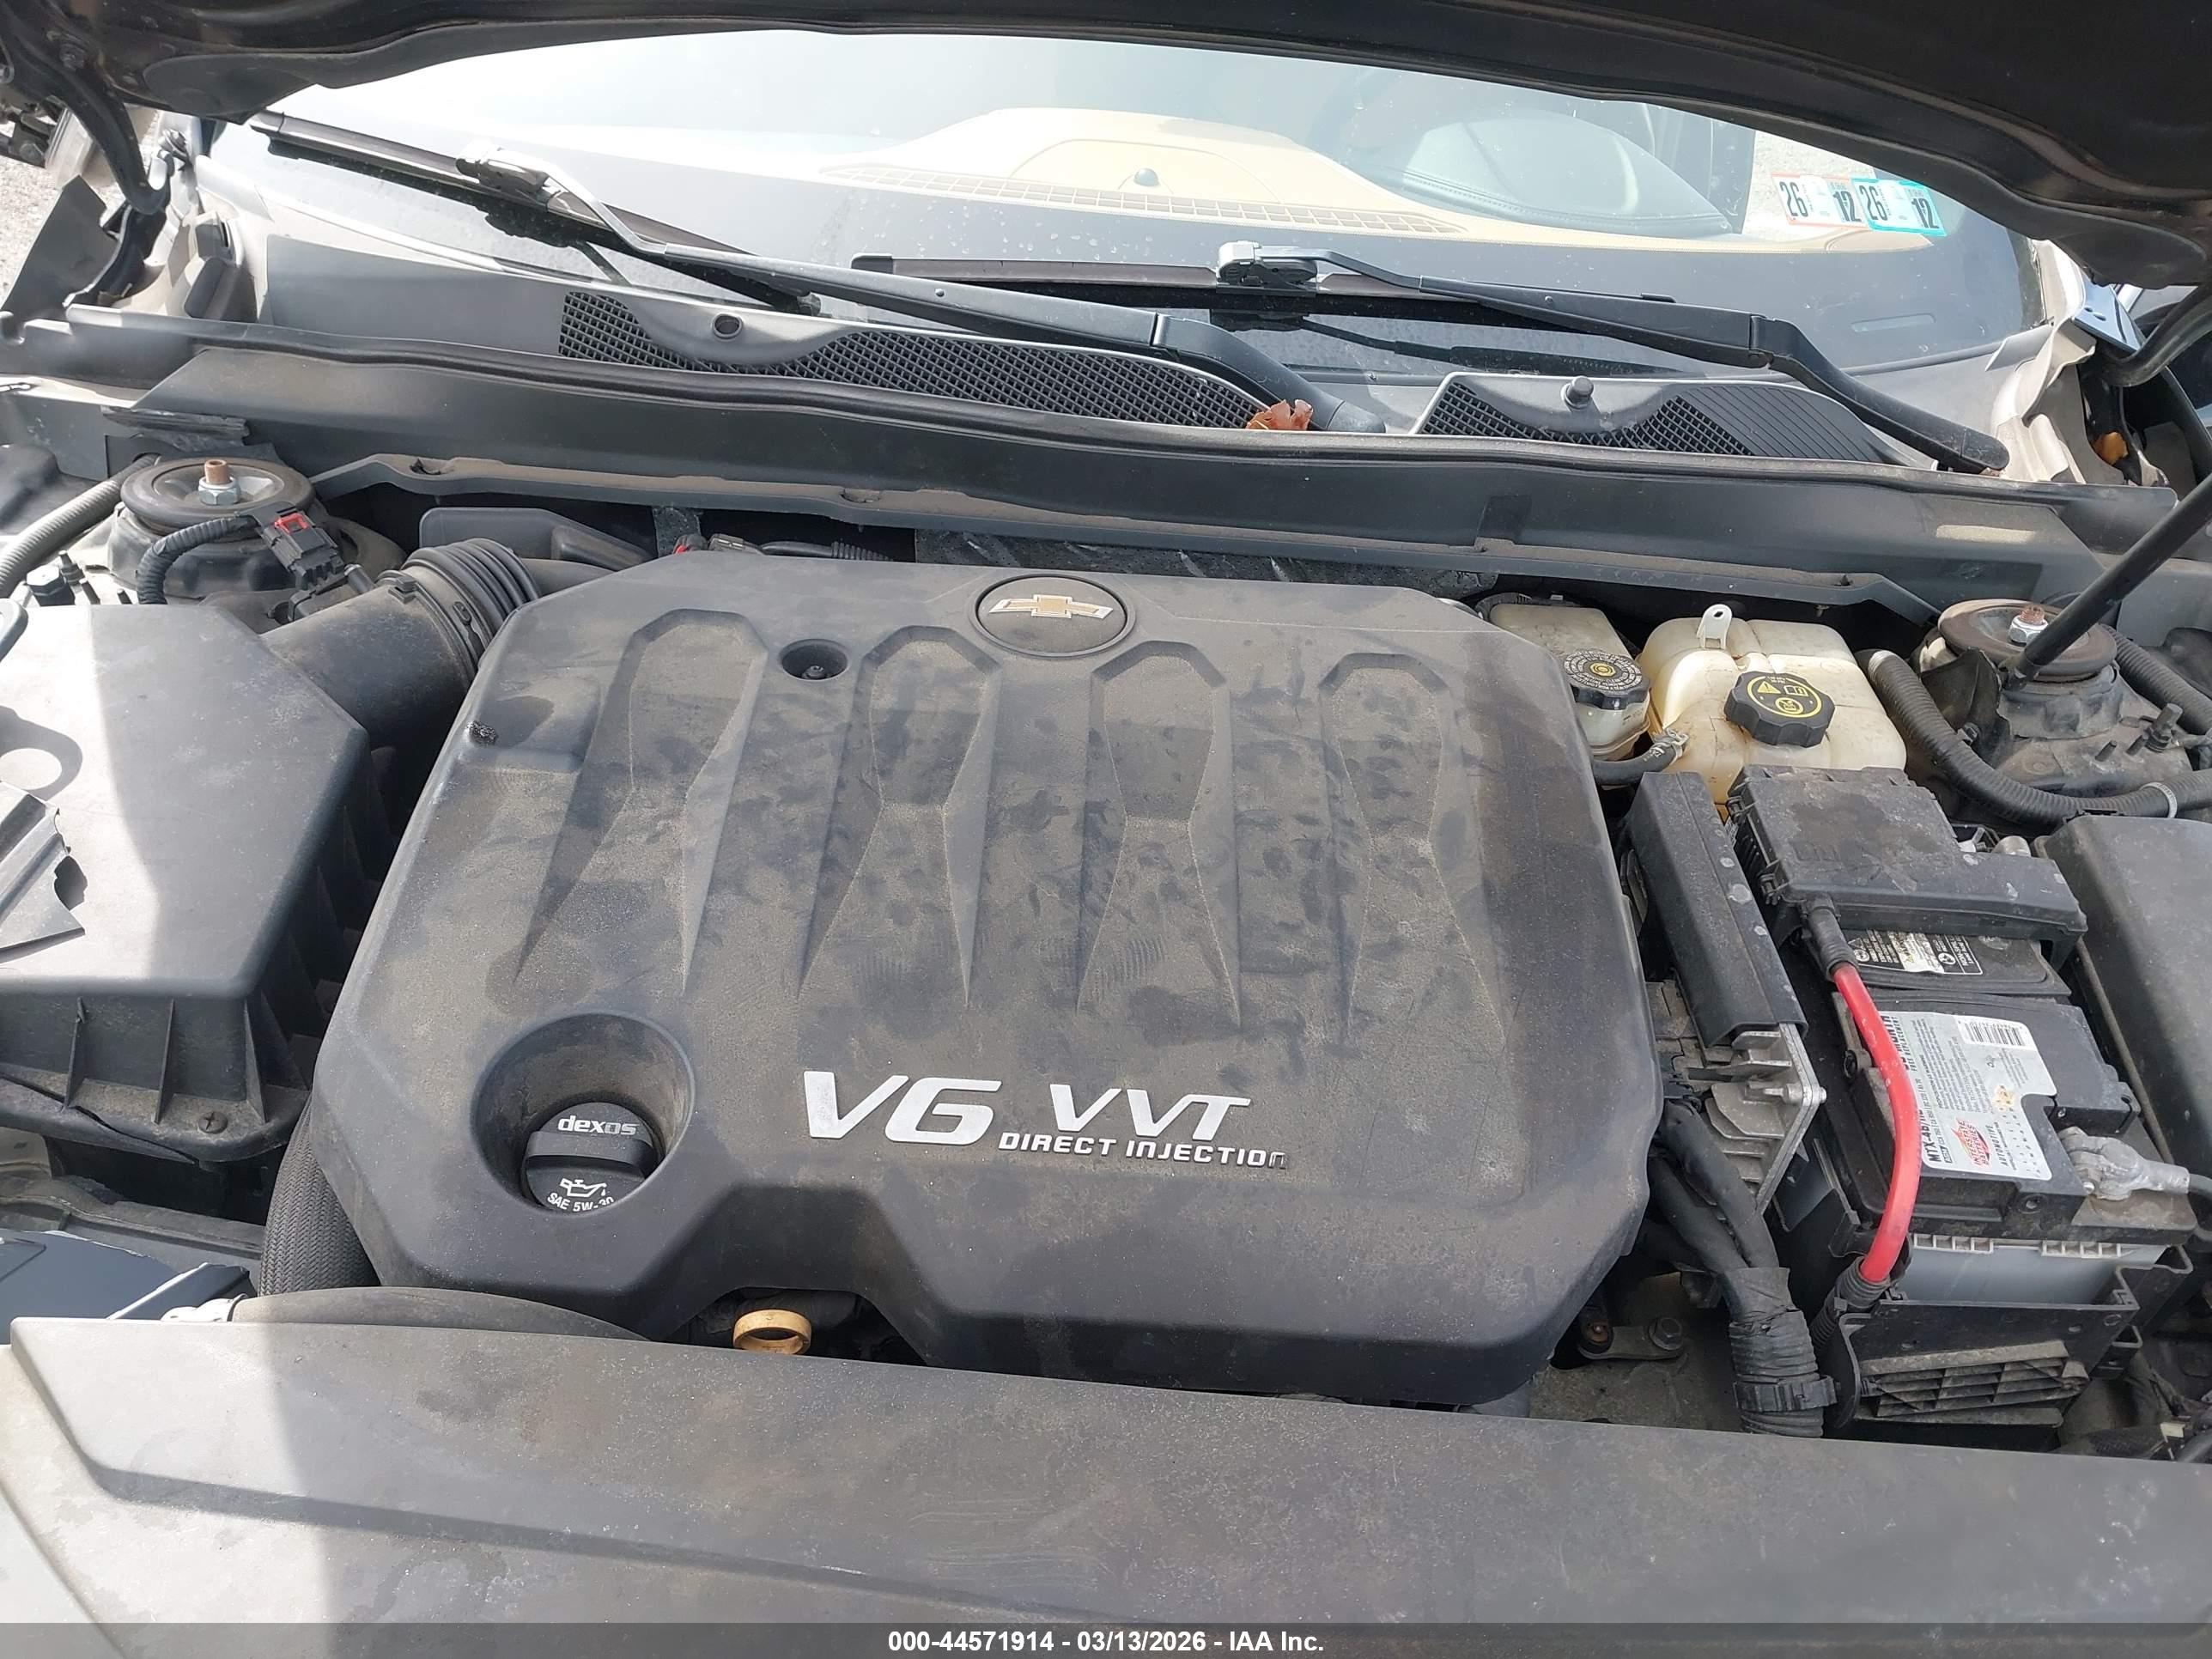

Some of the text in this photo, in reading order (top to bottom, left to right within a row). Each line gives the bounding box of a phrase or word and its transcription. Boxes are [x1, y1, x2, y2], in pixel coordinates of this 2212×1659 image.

[1779, 181, 1808, 217] 26
[1832, 191, 1862, 222] 12
[1859, 185, 1888, 221] 26
[1911, 198, 1940, 228] 12
[1891, 1017, 1911, 1055] REPLACEMENT
[1907, 1058, 1917, 1072] FREE
[557, 1115, 641, 1135] dexos
[804, 1070, 1251, 1146] V6 VVT
[998, 1131, 1287, 1169] DIRECT INJECTION
[1957, 1121, 1982, 1165] INTERSTATE
[1967, 1124, 1990, 1165] BATTERIES
[1985, 1125, 2008, 1166] AUTOMOTIVE
[547, 1192, 571, 1210] SAE
